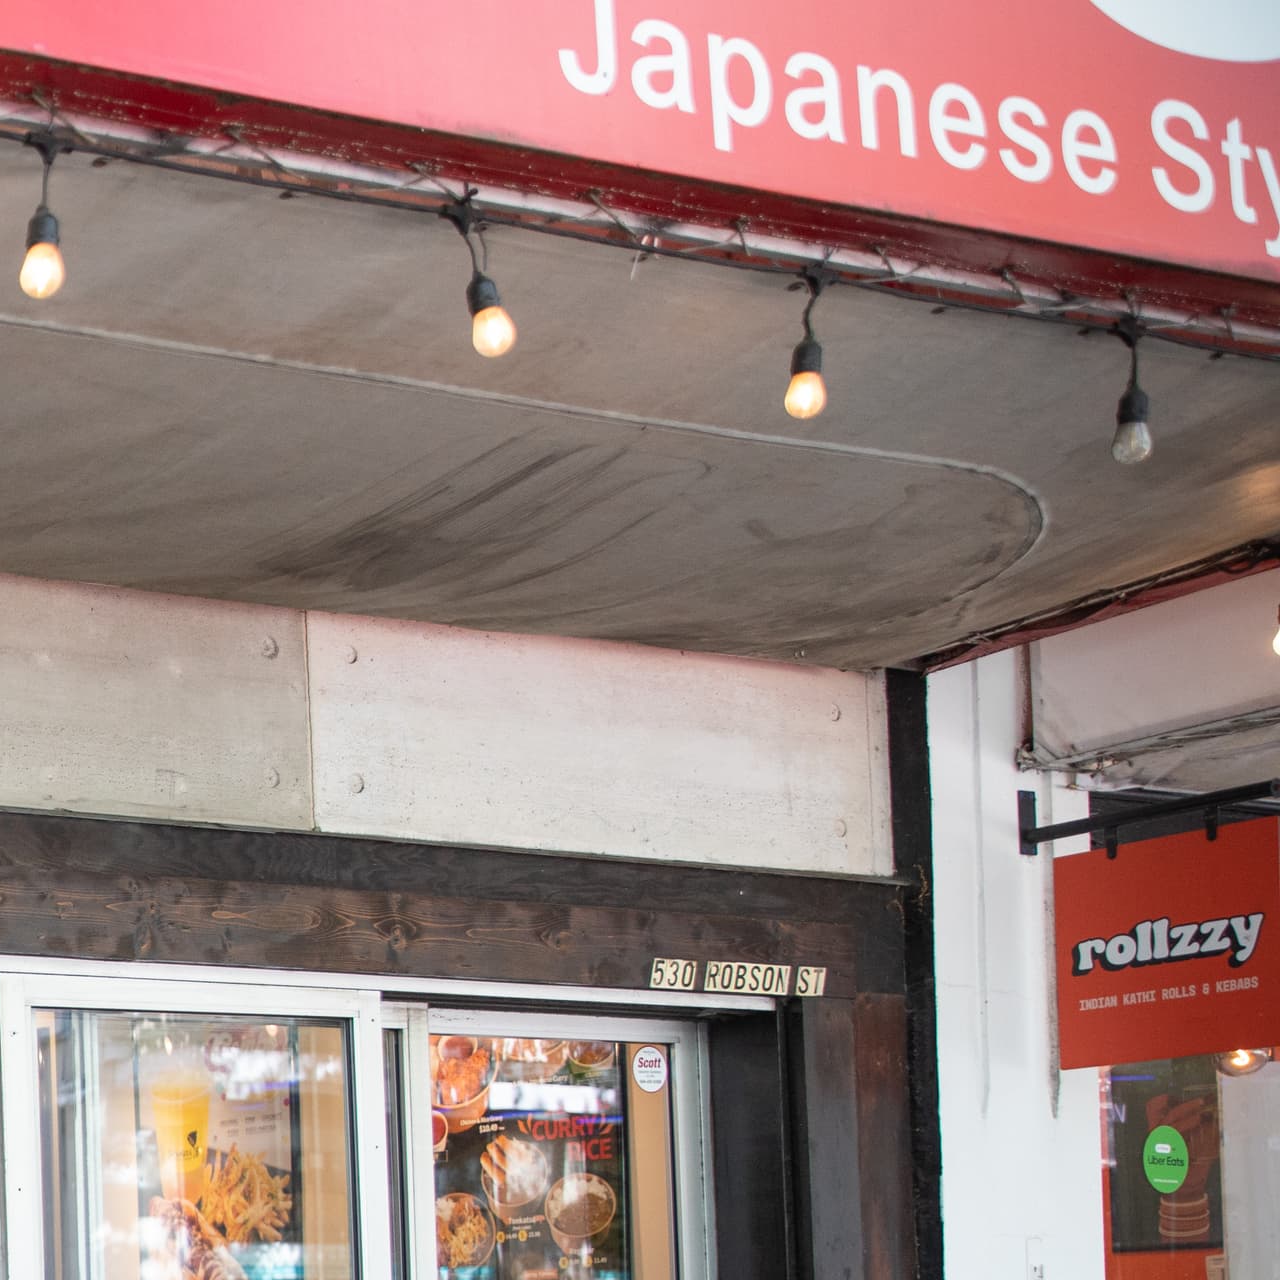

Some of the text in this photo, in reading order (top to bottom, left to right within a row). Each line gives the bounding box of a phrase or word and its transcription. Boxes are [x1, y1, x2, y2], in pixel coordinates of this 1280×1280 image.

[557, 0, 1118, 196] Japanese
[1073, 912, 1265, 976] rollzzy
[652, 959, 824, 994] 530 ROBSON ST
[1079, 996, 1118, 1011] INDIAN
[1122, 990, 1157, 1006] KATHI
[1161, 984, 1197, 1000] ROLLS
[1215, 976, 1260, 993] KEBABS
[637, 1057, 661, 1069] Scott
[531, 1114, 596, 1141] CURRY
[566, 1138, 613, 1161] RICE
[1148, 1155, 1185, 1167] Uber Eats
